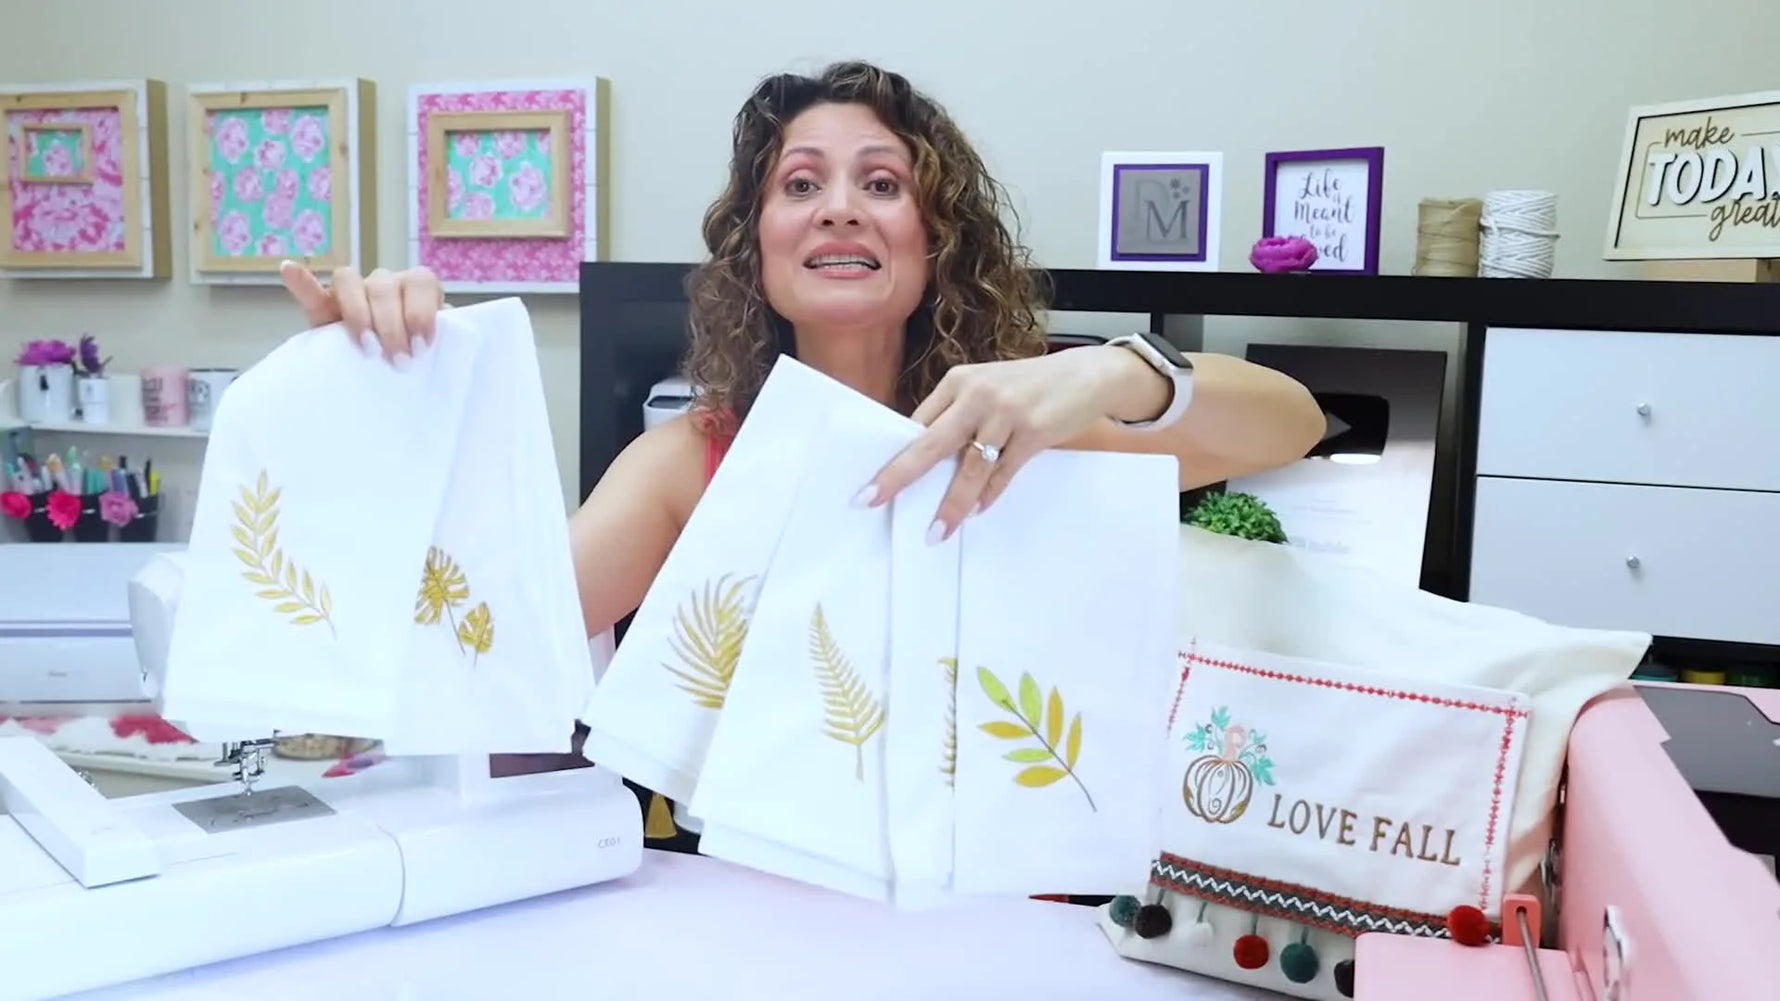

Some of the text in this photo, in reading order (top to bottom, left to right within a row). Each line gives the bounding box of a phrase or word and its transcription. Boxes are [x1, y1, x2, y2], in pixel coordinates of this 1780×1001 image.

[1664, 116, 1735, 149] make
[1300, 168, 1340, 200] Life
[1294, 195, 1354, 224] Meant
[1267, 793, 1462, 867] LOVE FALL
